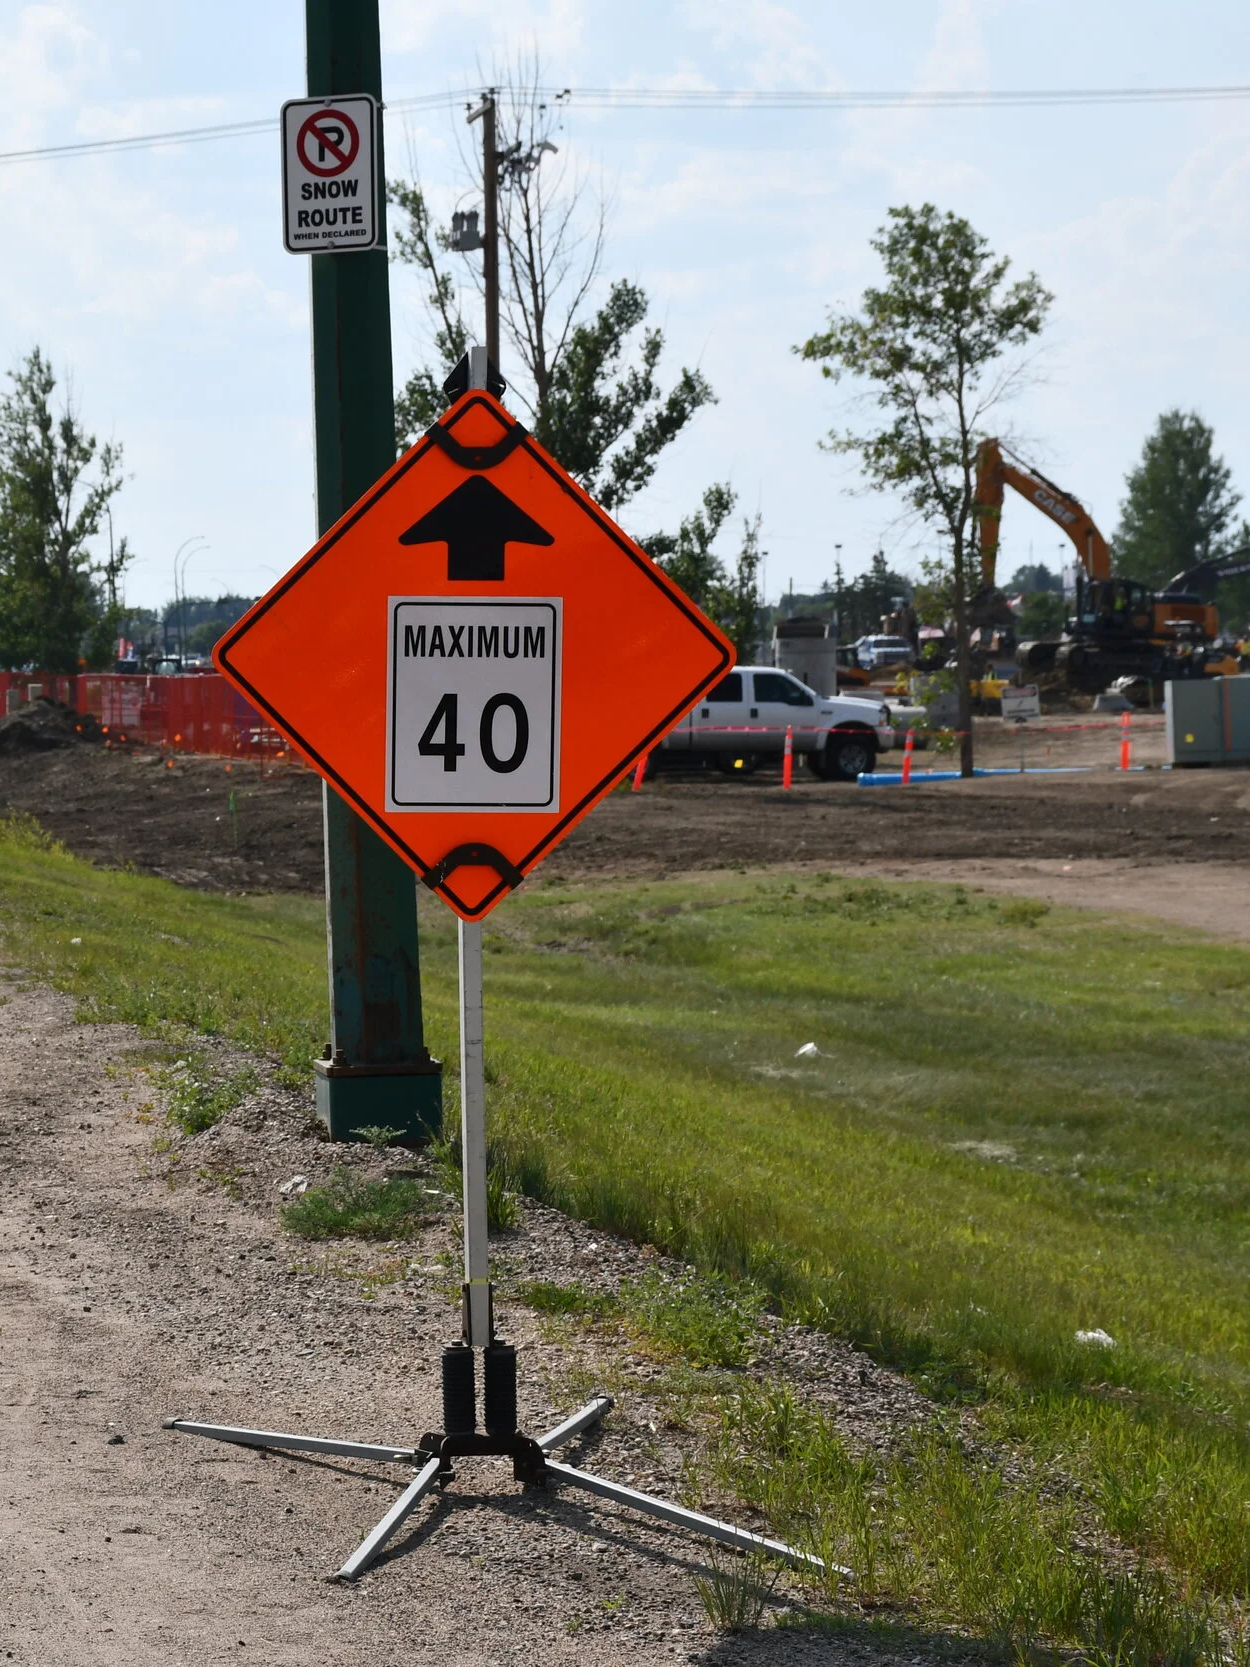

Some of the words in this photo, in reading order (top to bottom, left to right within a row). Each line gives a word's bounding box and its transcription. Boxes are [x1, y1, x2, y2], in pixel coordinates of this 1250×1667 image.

[301, 179, 359, 201] SNOW
[297, 206, 363, 228] ROUTE
[293, 231, 320, 242] WHEN
[322, 229, 367, 239] DECLARED
[403, 625, 546, 658] MAXIMUM
[417, 692, 530, 774] 40
